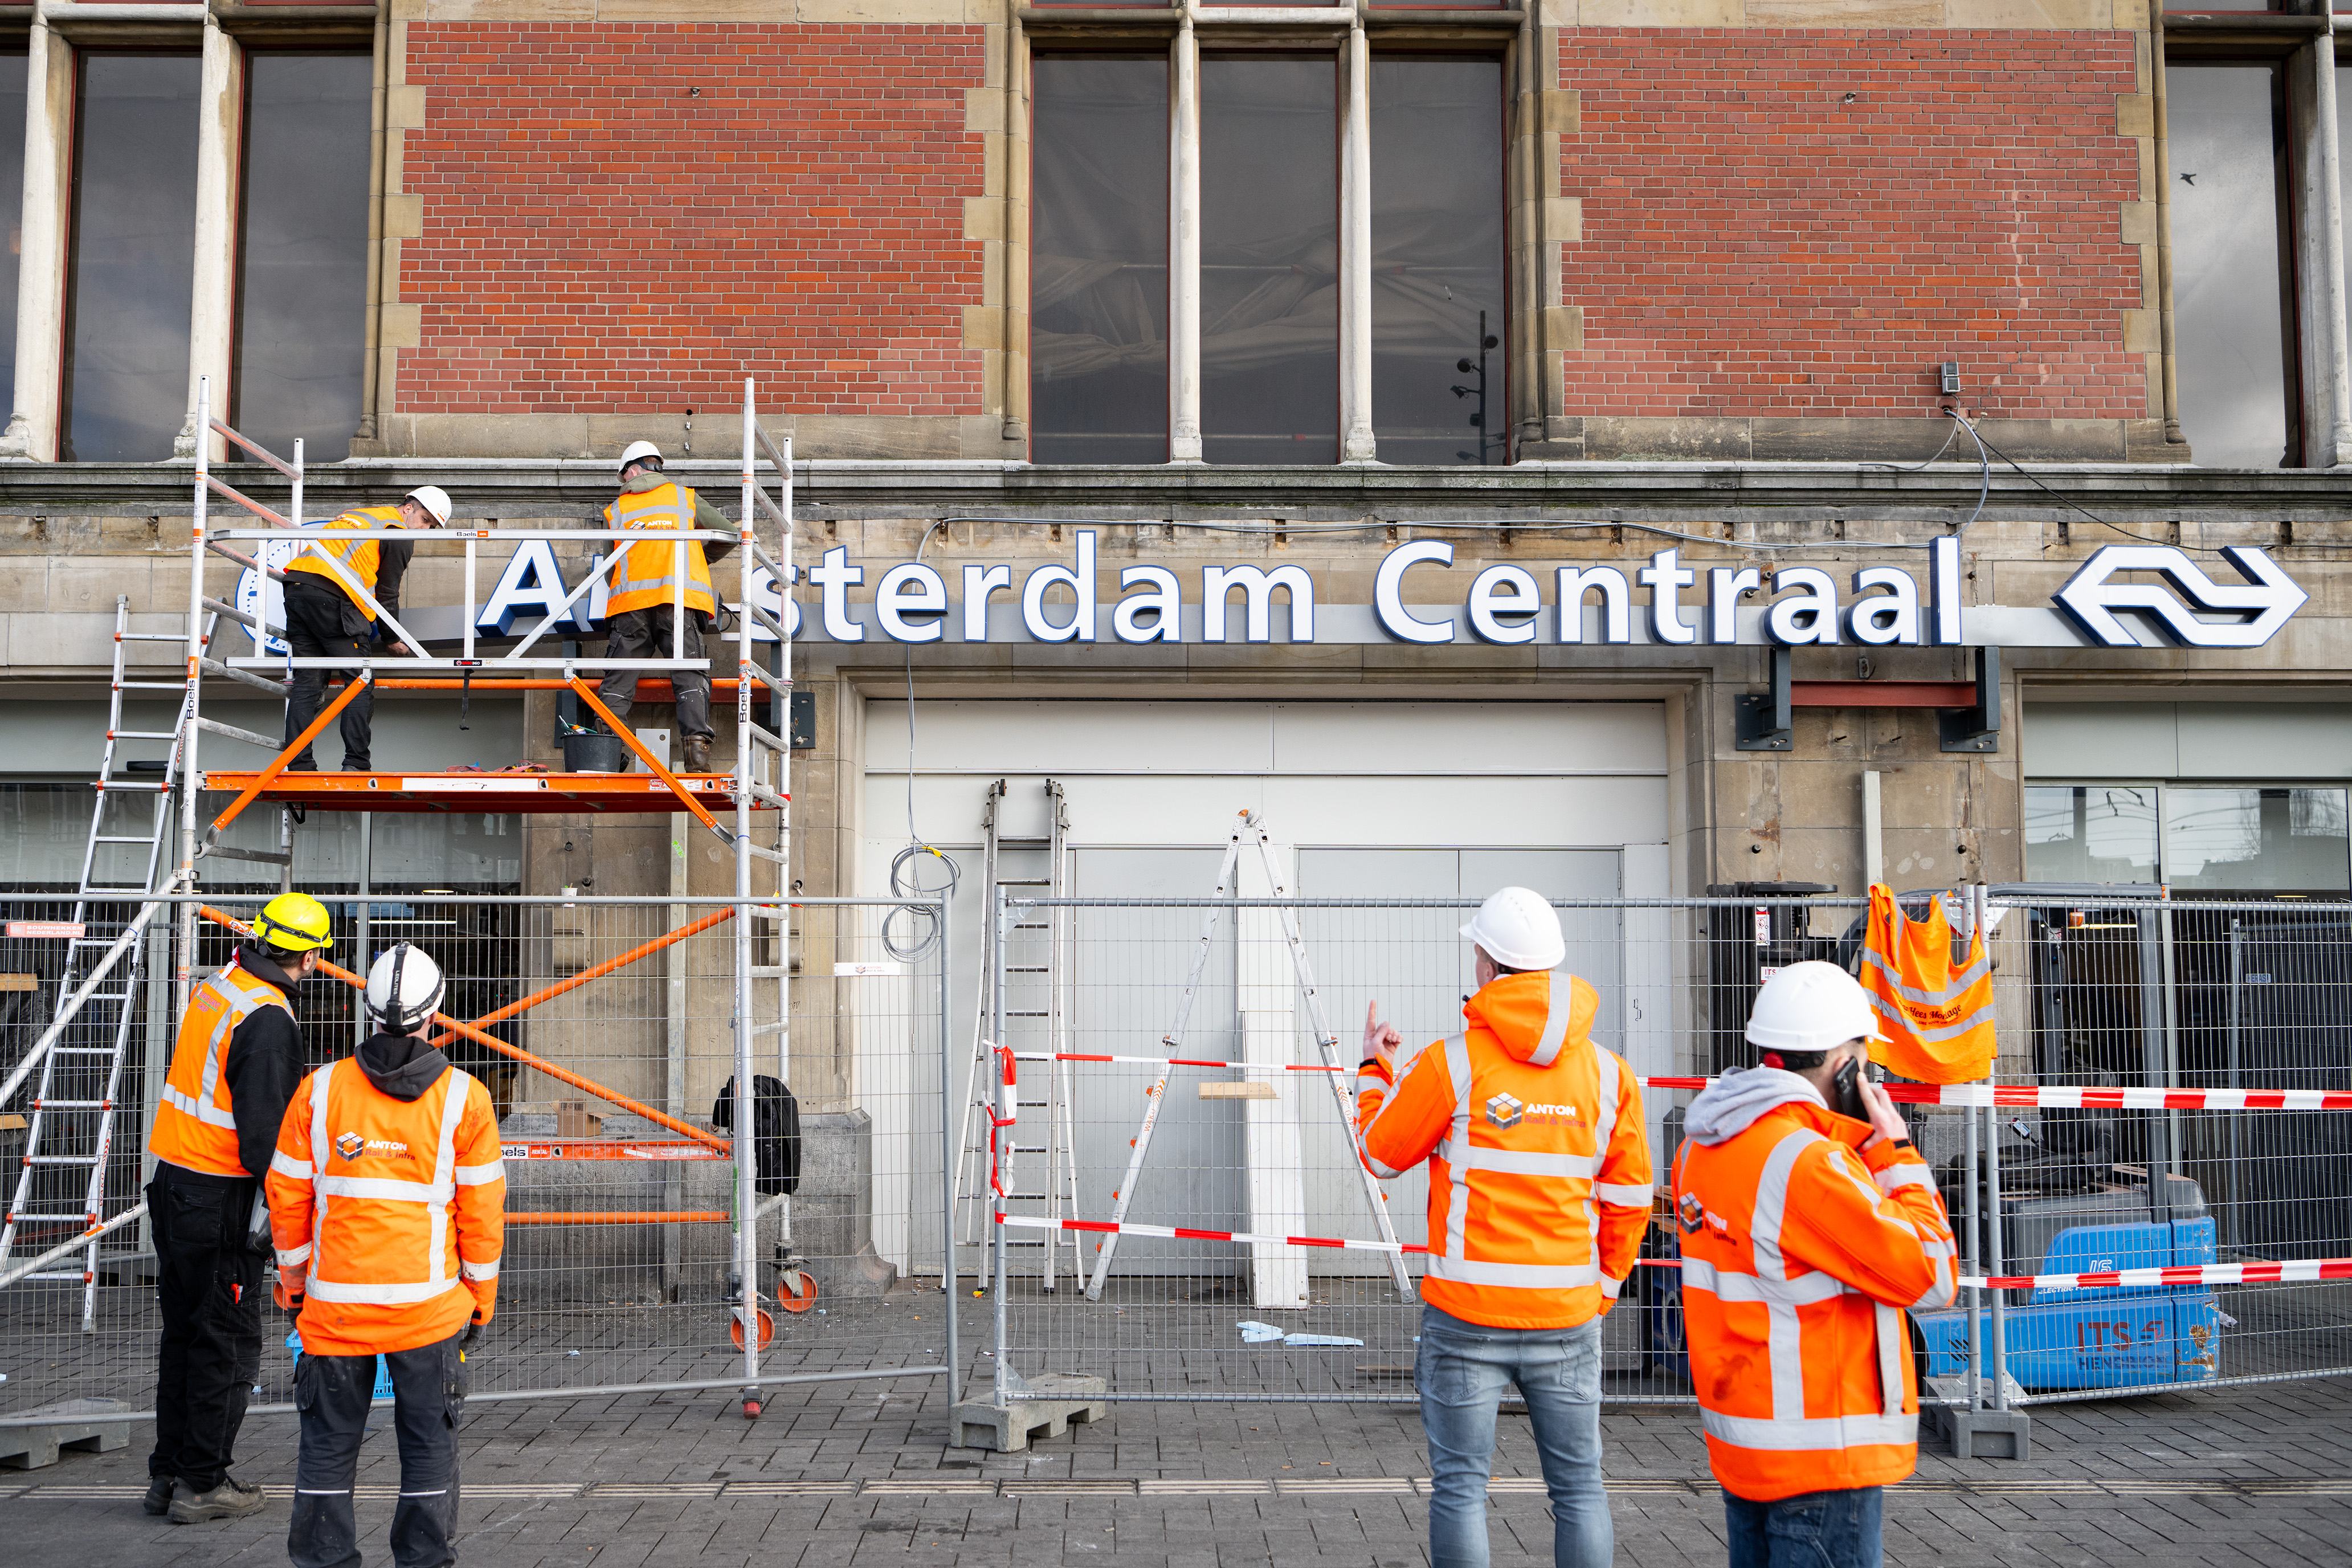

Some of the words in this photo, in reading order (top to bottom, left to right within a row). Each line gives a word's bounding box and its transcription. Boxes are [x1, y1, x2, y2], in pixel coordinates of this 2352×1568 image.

[475, 530, 1314, 644] Asterdam
[1373, 536, 1962, 646] Centraal
[186, 680, 195, 720] Boels
[739, 683, 748, 724] Boels
[1910, 1007, 1926, 1019] Hees
[1525, 1103, 1576, 1116] ANTON
[1525, 1115, 1545, 1124] Rail
[1550, 1116, 1558, 1125] &
[1562, 1117, 1586, 1128] Infra
[366, 1140, 407, 1151] ANTON
[501, 1147, 526, 1157] els
[395, 1152, 415, 1160] Infra
[2077, 1321, 2132, 1351] ITS
